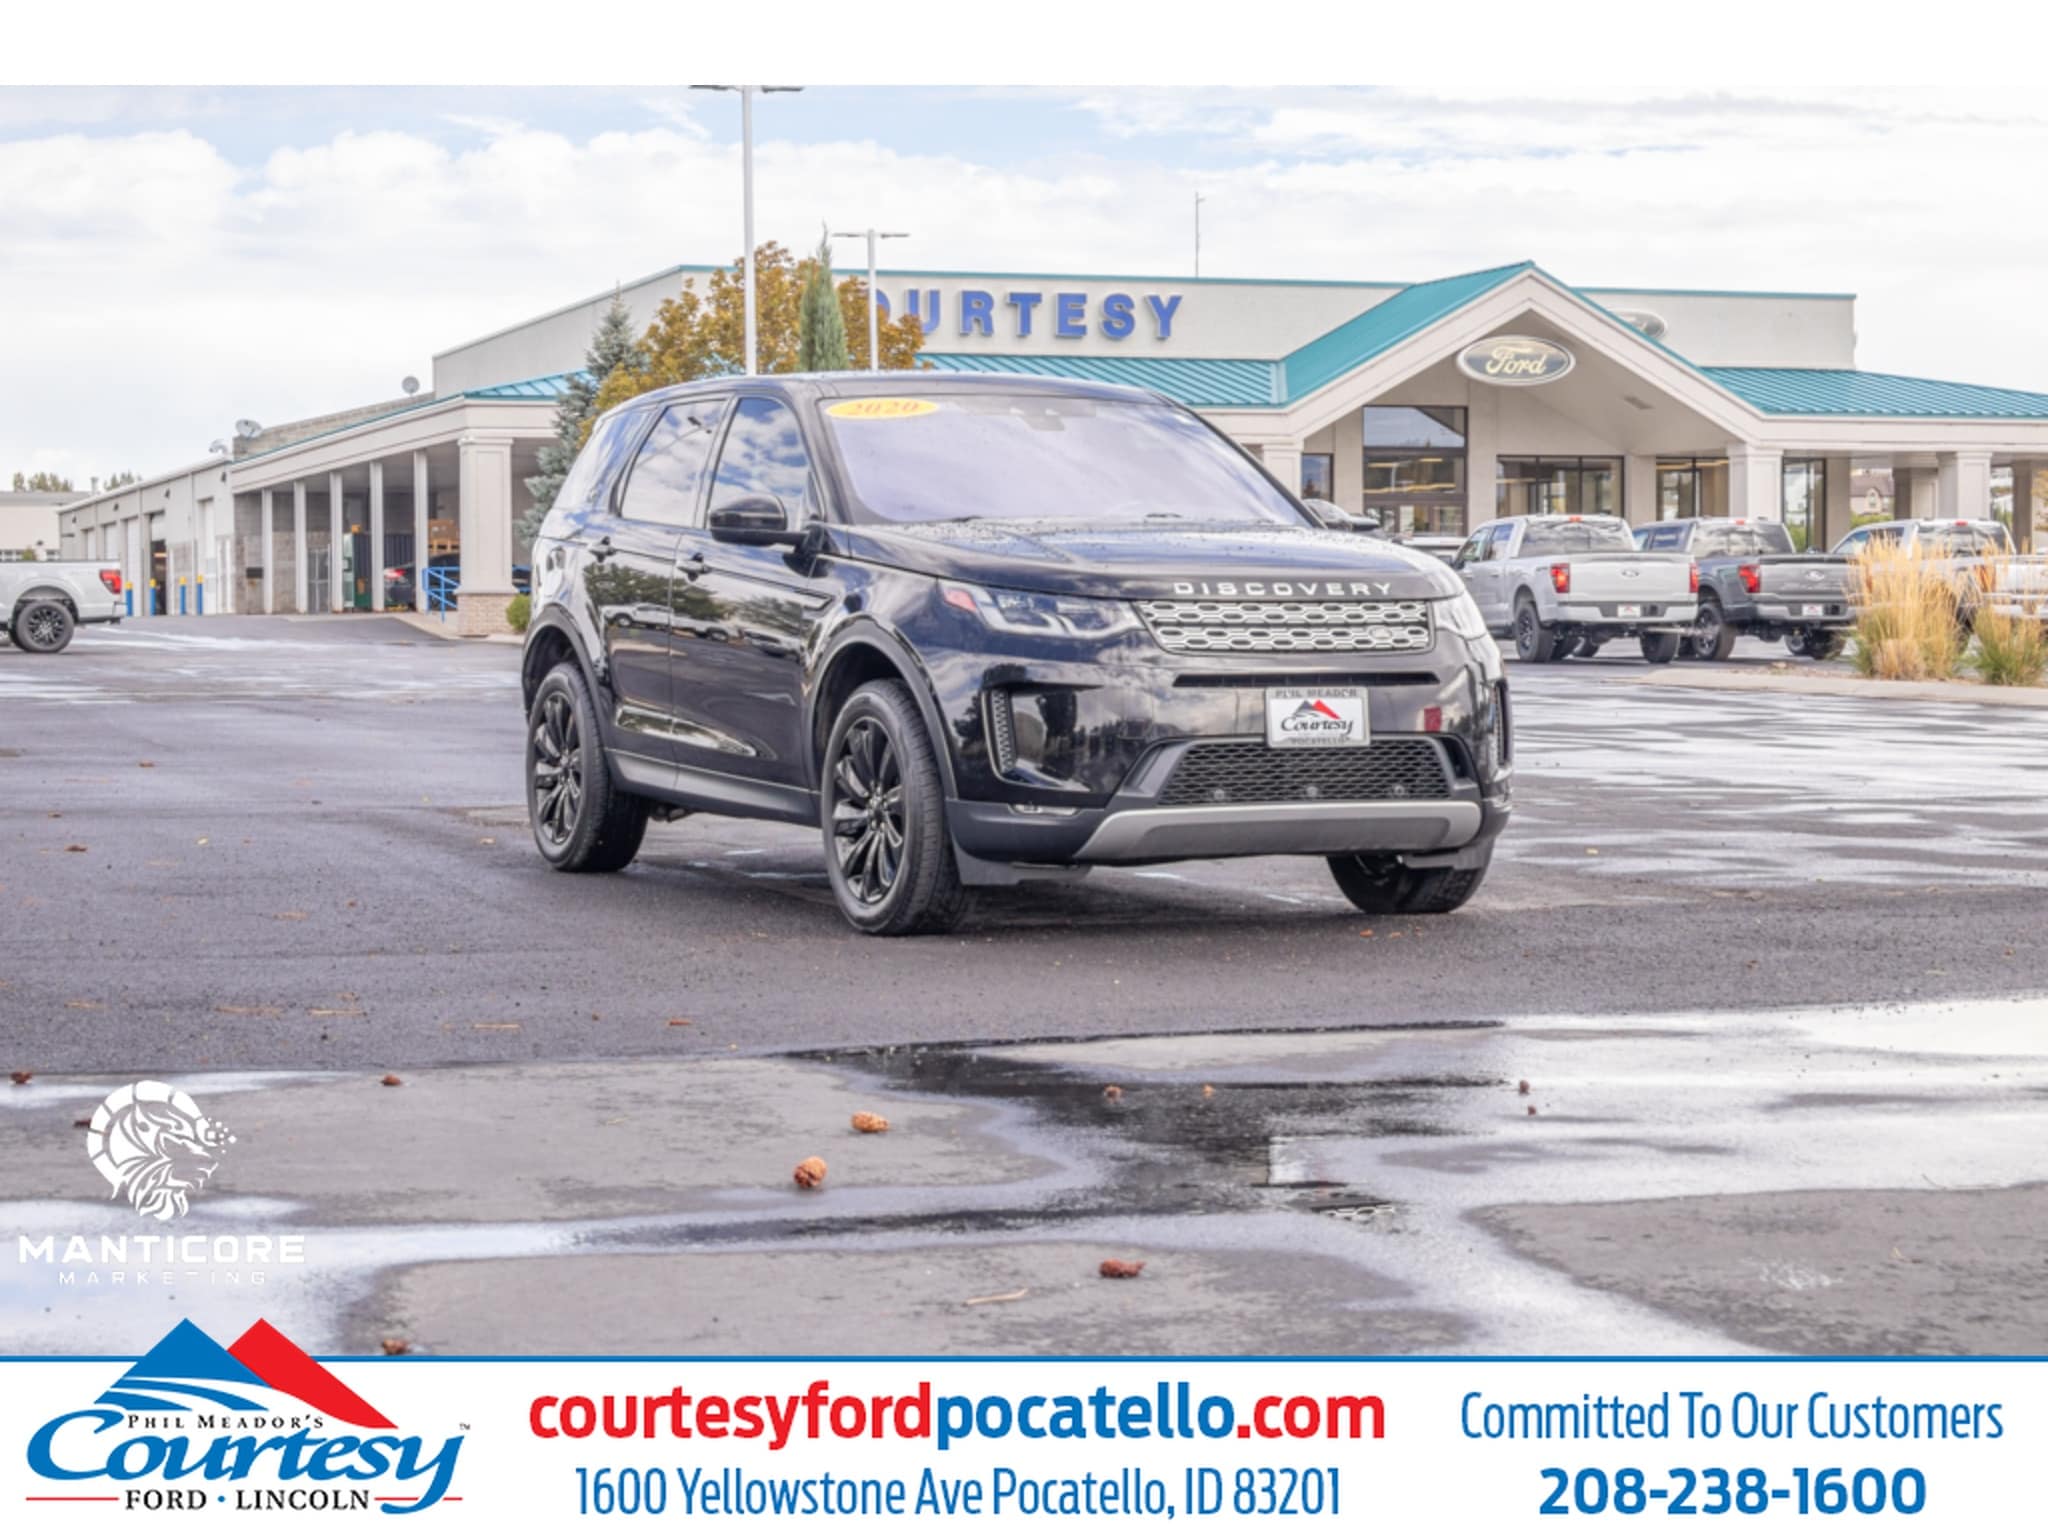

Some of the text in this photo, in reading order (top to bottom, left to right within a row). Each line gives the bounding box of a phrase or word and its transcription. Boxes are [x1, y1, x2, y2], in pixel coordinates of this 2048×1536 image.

[876, 288, 1184, 340] URTESY
[1485, 345, 1547, 375] Ford
[847, 401, 920, 416] 2020
[1174, 582, 1392, 596] DISCOVERY
[1281, 716, 1354, 736] Courtesy
